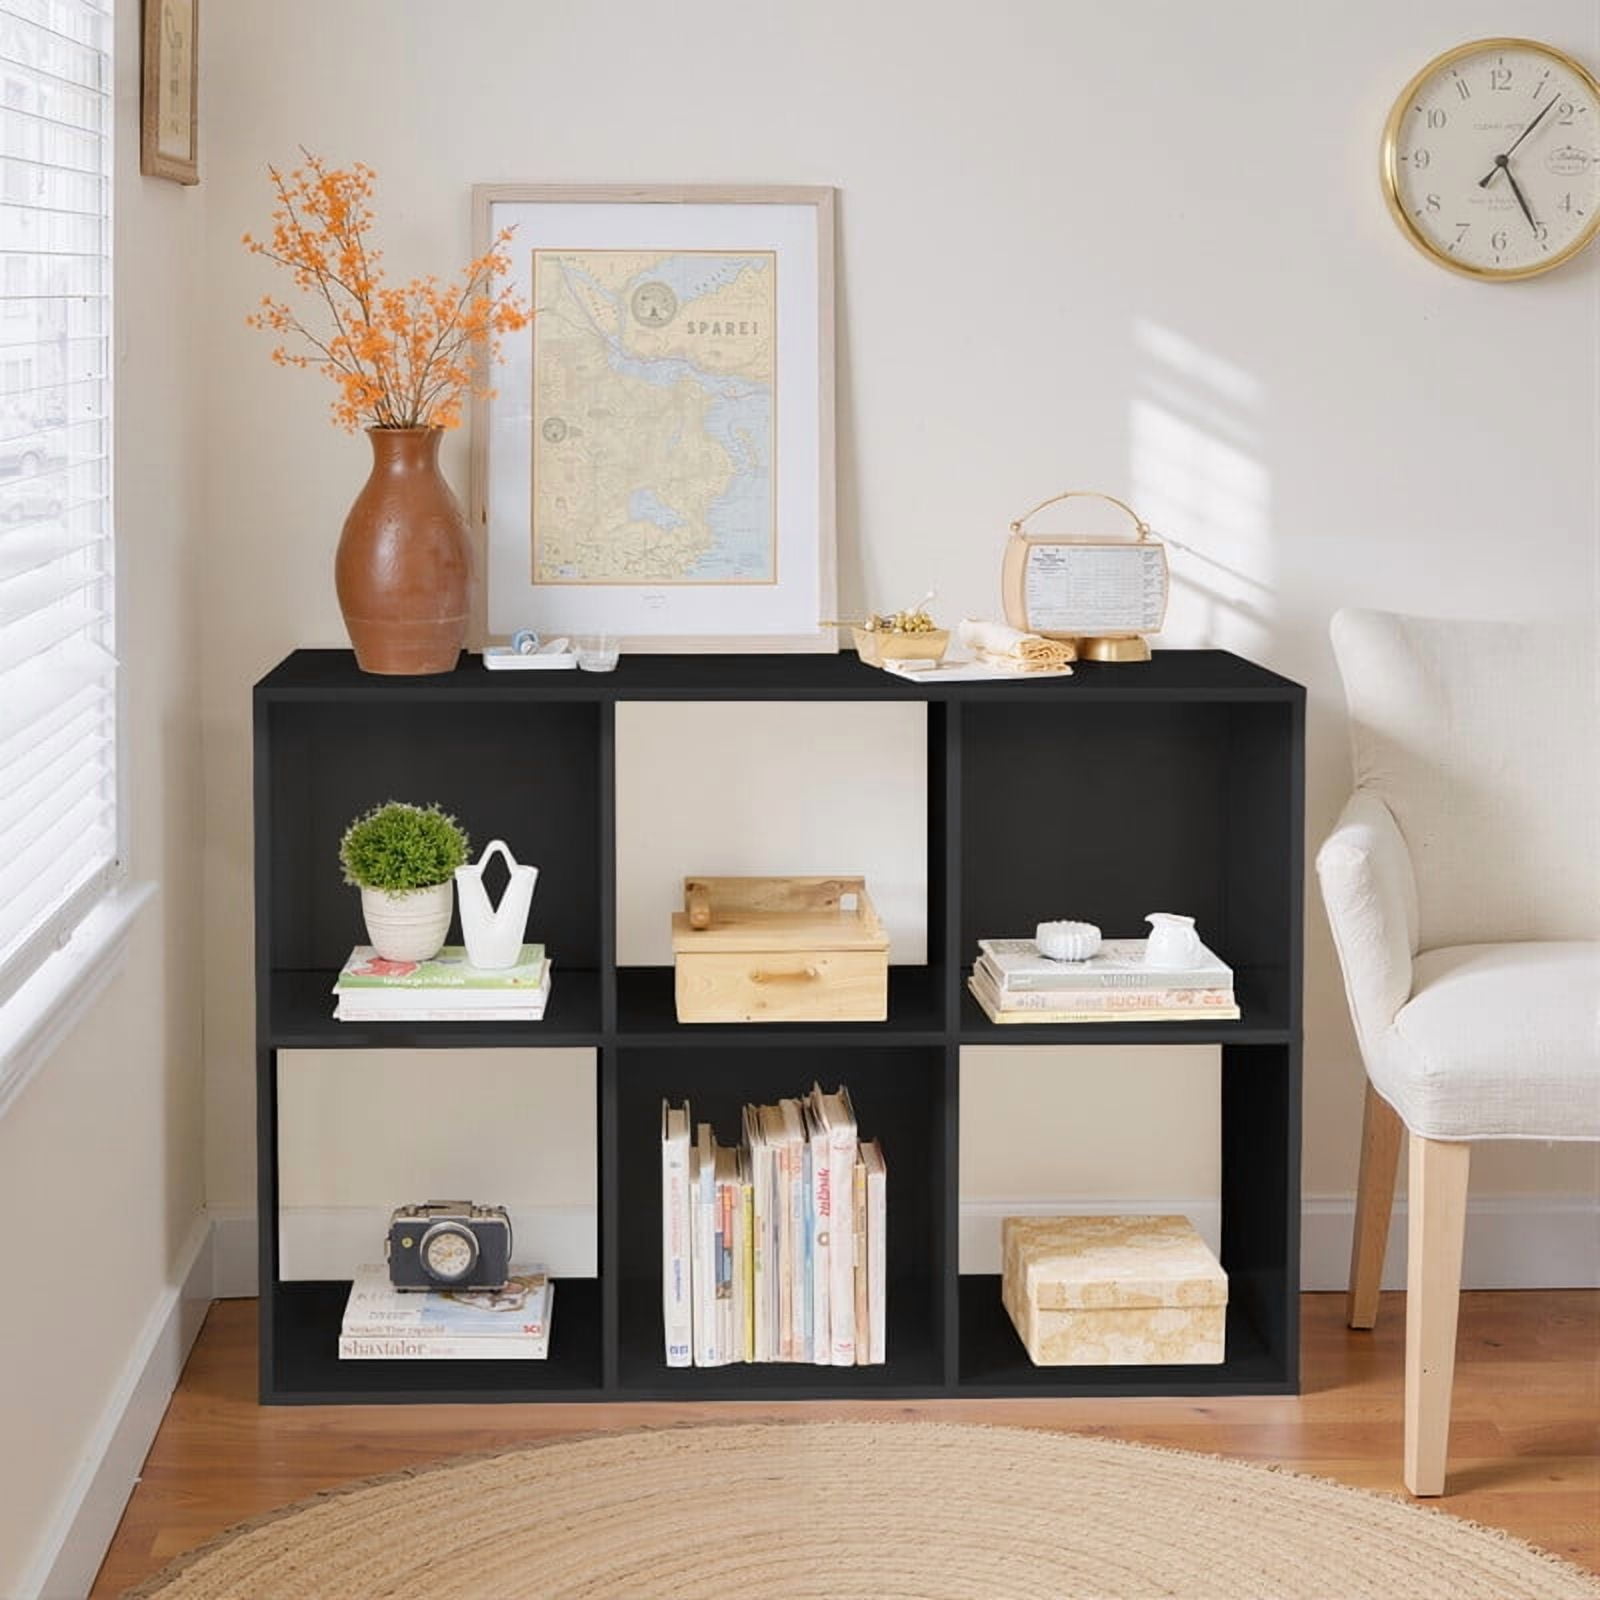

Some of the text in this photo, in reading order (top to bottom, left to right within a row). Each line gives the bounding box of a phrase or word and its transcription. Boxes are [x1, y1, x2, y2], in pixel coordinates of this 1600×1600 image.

[1455, 79, 1471, 100] 11
[1490, 69, 1512, 91] 12
[1532, 80, 1545, 99] 1
[1426, 109, 1447, 129] 10
[1557, 103, 1574, 126] 2
[1414, 149, 1430, 169] 9
[1426, 193, 1441, 213] 8
[1557, 192, 1572, 213] 4
[1455, 223, 1471, 243] 7
[1491, 231, 1507, 250] 6
[1533, 221, 1548, 242] 5
[687, 321, 758, 336] SPAREI
